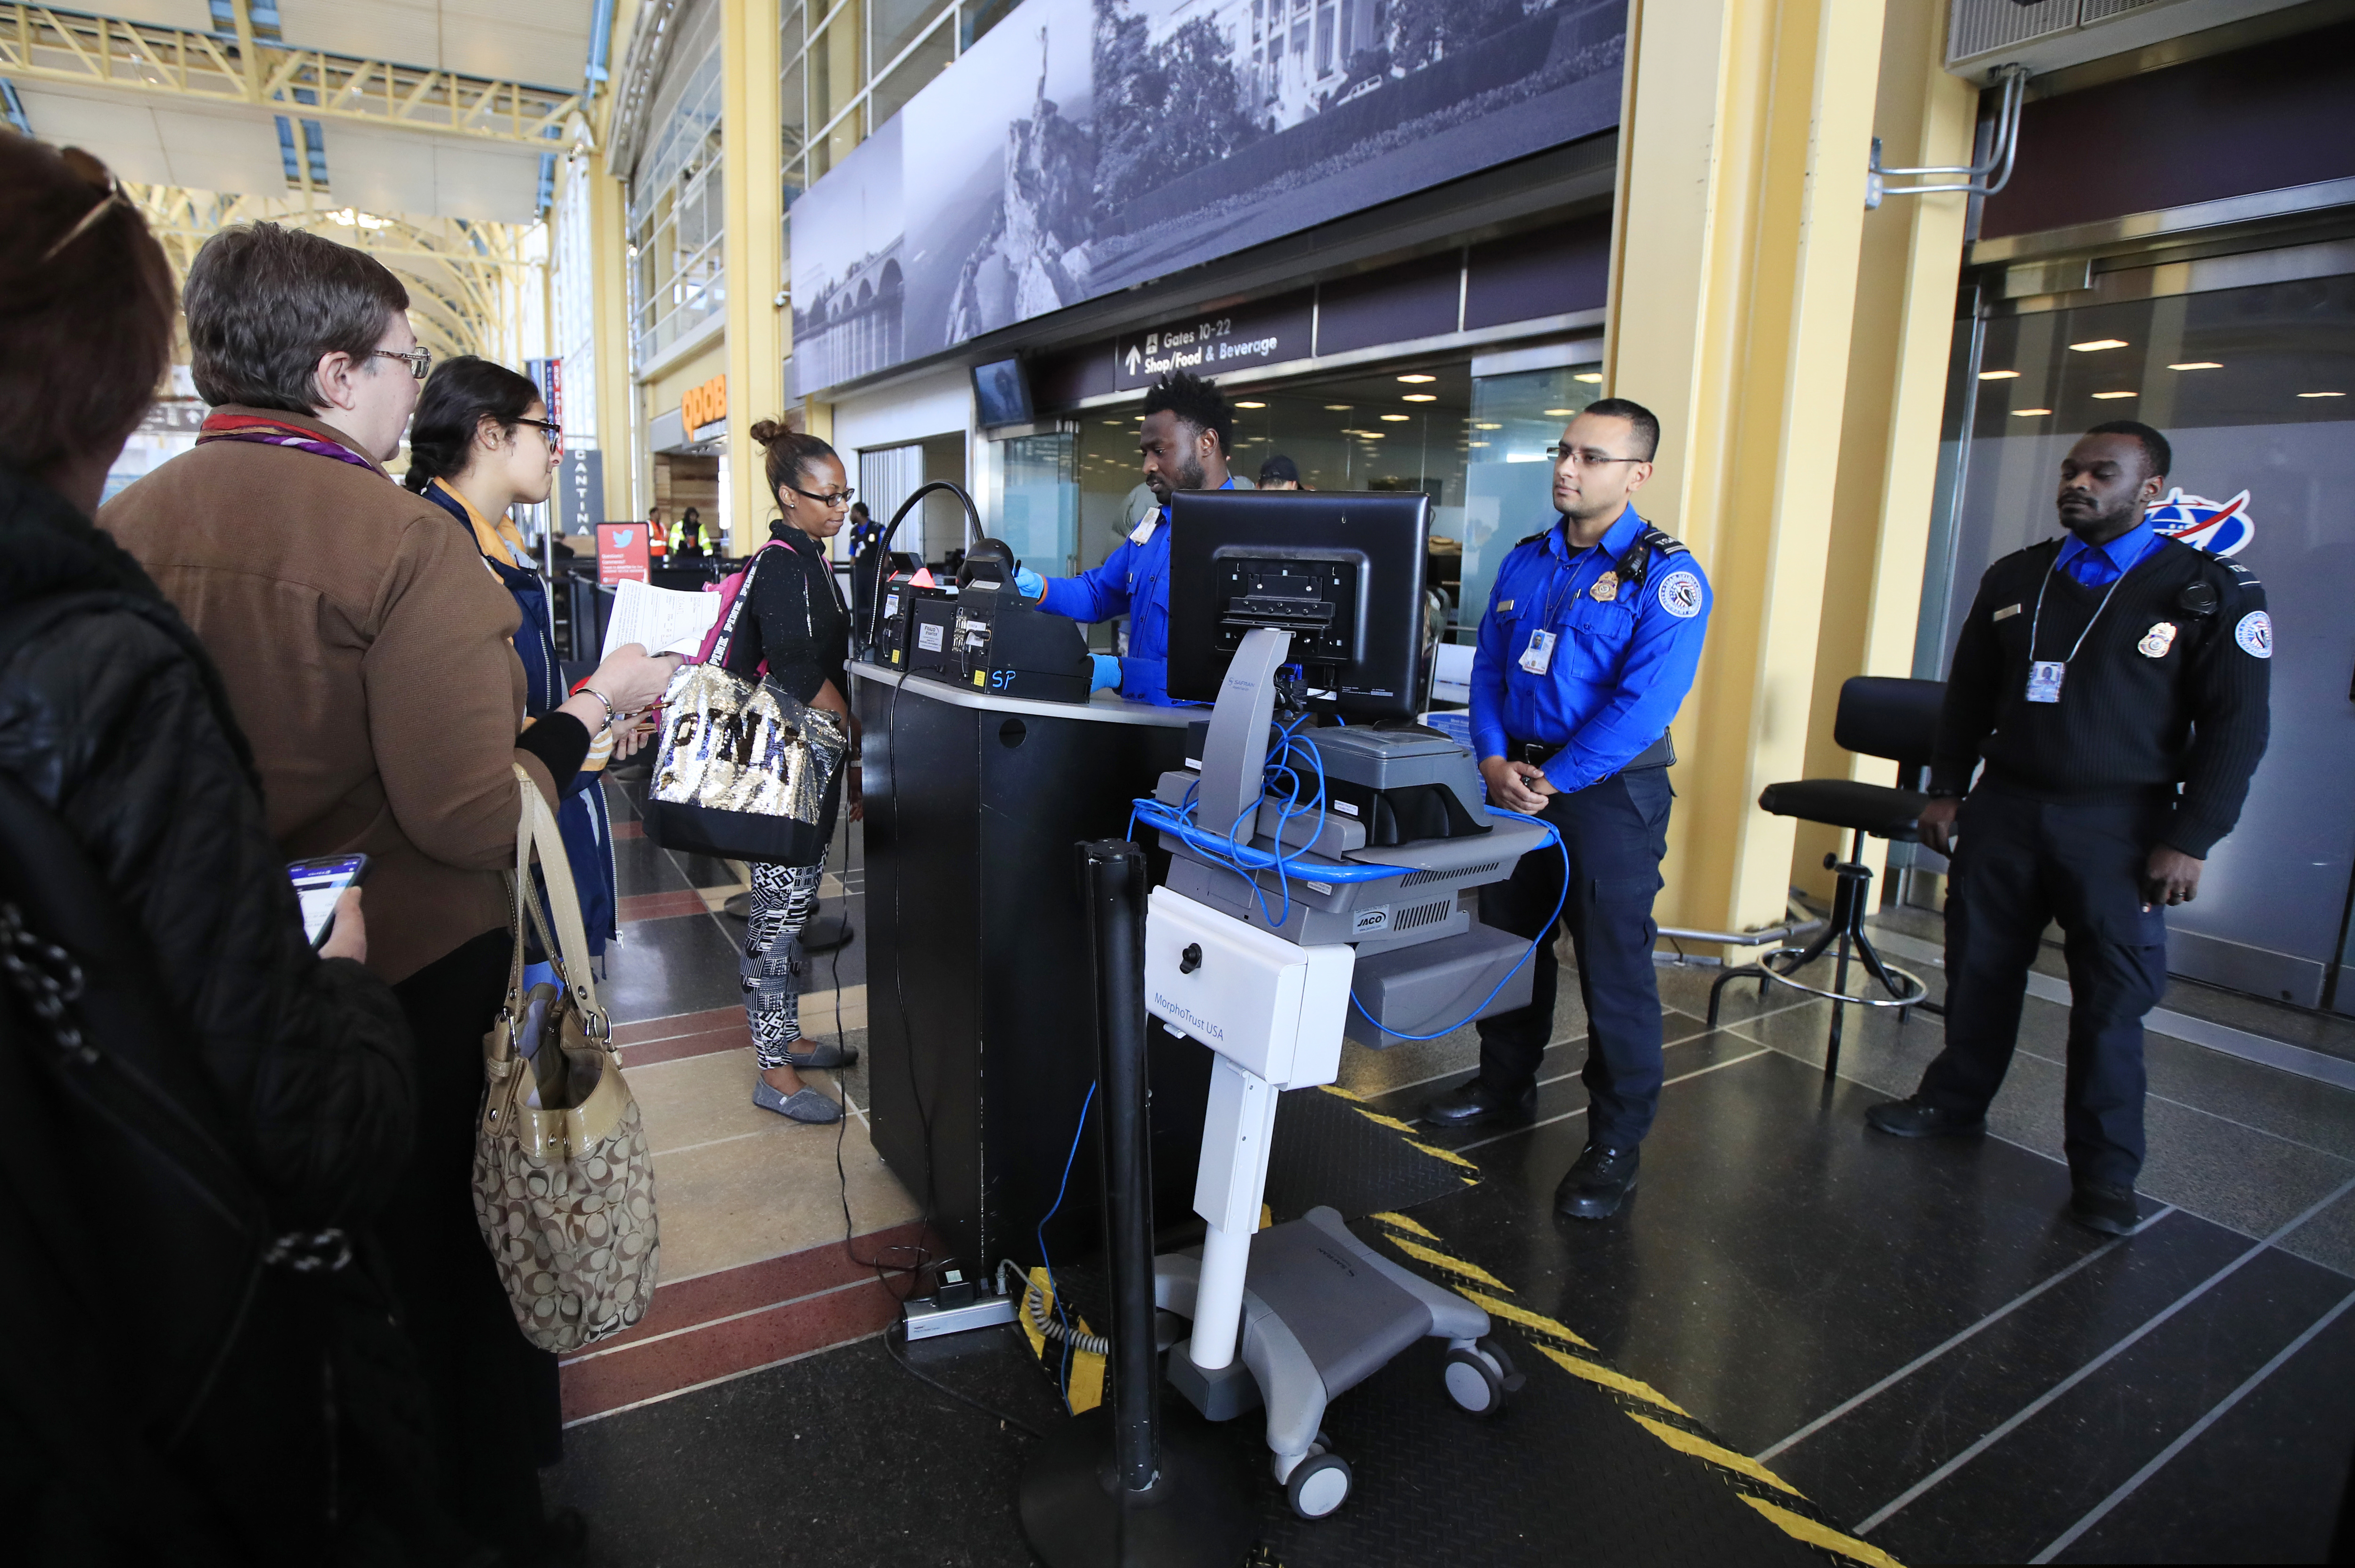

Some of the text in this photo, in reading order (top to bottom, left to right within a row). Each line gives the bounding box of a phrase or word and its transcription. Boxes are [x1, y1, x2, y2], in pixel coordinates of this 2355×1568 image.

[1163, 318, 1231, 348] Gates 10-22
[1144, 337, 1277, 374] Shop/Food & Beverage
[681, 374, 727, 443] QDOB
[574, 450, 590, 536] CANTINA
[739, 565, 757, 597] PINK
[723, 600, 743, 632] PINK
[709, 636, 729, 667] PINK
[992, 670, 1016, 690] SP
[1357, 915, 1382, 927] JACO
[1155, 992, 1223, 1041] MorphoTrust USA
